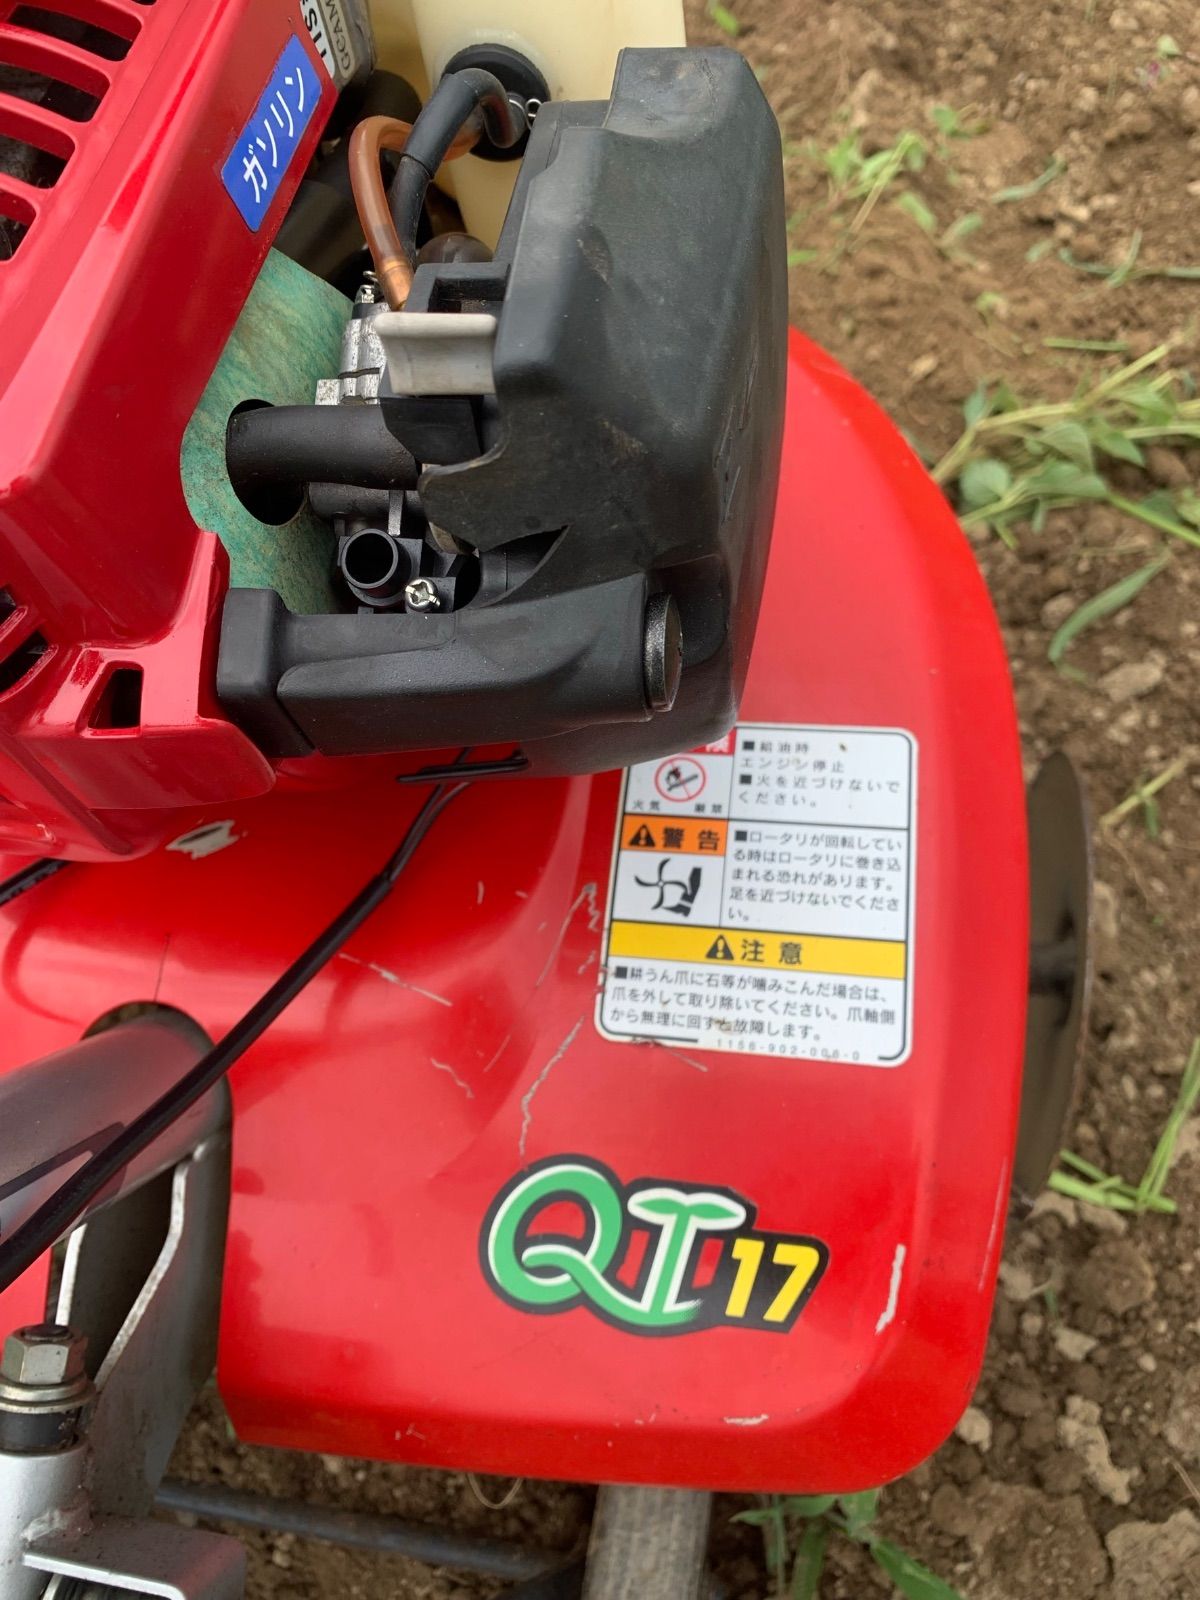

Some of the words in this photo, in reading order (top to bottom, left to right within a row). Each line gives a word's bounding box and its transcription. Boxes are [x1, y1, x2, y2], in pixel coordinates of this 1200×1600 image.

[243, 67, 304, 203] ガソリン
[663, 826, 720, 851] 警告
[742, 938, 802, 965] 注意
